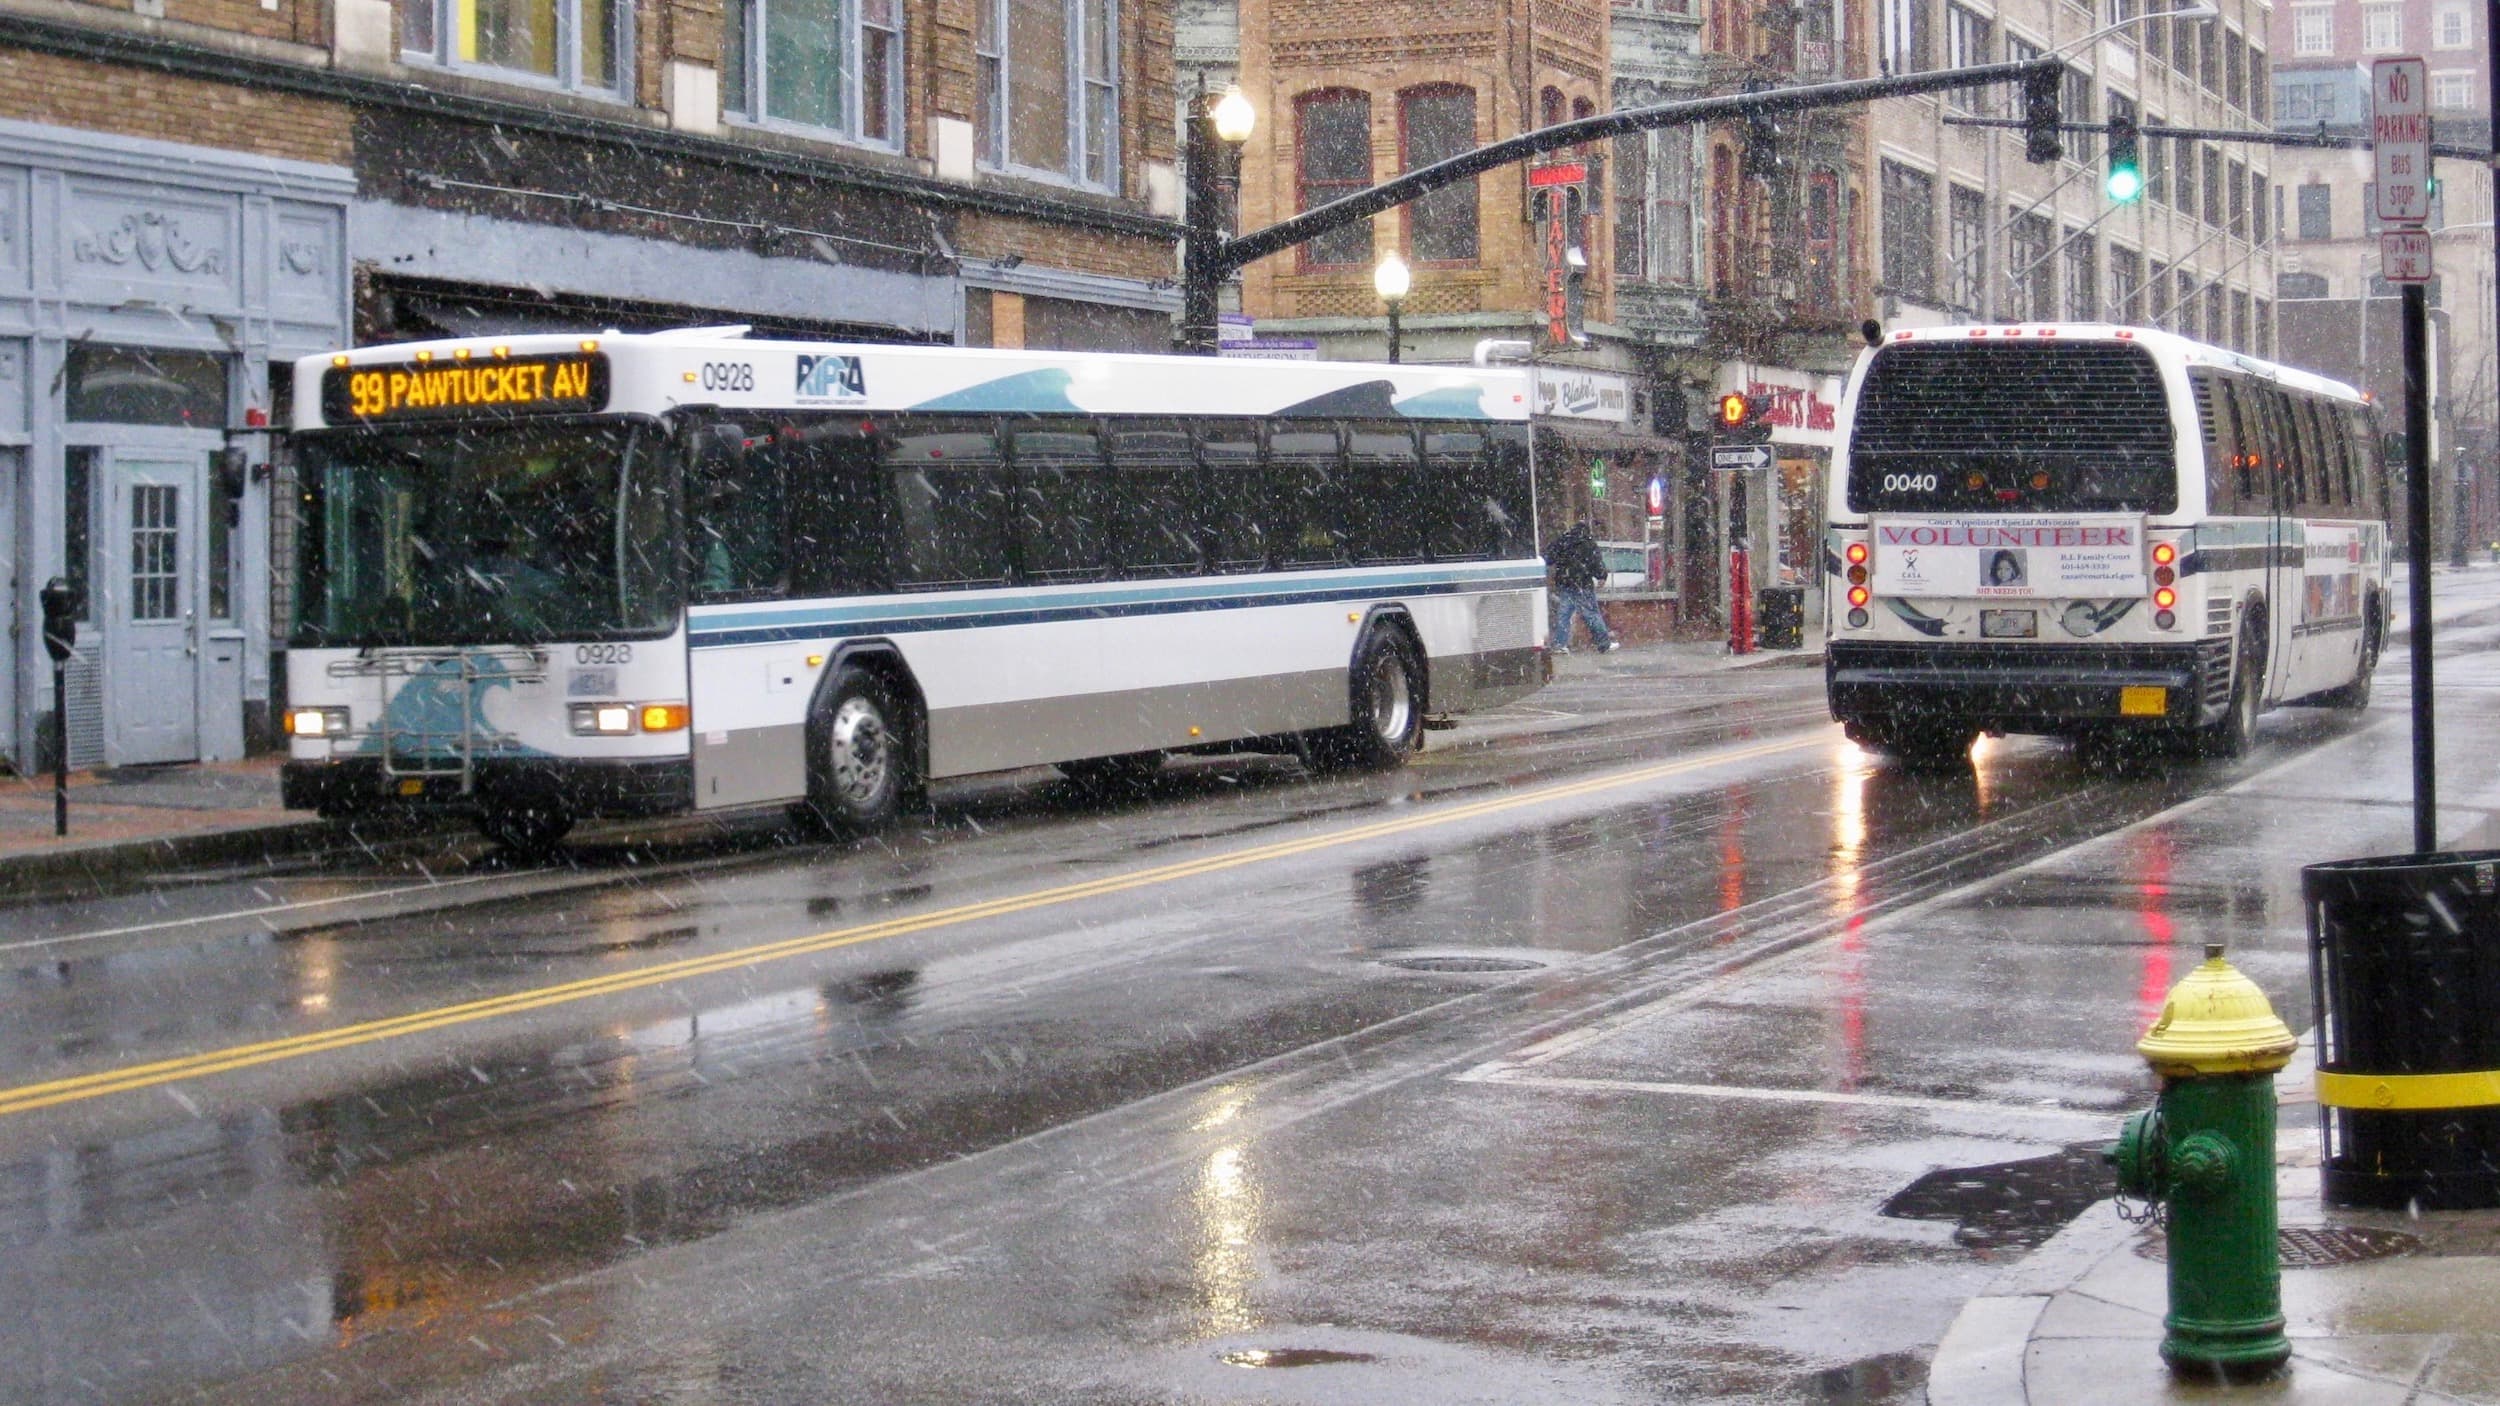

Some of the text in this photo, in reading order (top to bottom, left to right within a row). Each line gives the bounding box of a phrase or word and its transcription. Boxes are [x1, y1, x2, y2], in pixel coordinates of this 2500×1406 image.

[2389, 74, 2409, 103] NO
[2377, 114, 2424, 144] PARKING
[2391, 154, 2412, 176] BUS
[2390, 185, 2415, 206] STOP
[1550, 191, 1566, 345] TAVERN
[2394, 258, 2416, 273] ZONE
[702, 362, 754, 392] 0928
[352, 362, 588, 415] 99 PAWTUCKET AV
[1562, 376, 1598, 408] Blake's
[1717, 454, 1753, 464] ONE WAY
[1884, 474, 1937, 492] 0040
[1955, 518, 2000, 527] Appointed
[2002, 518, 2034, 526] Special
[1882, 527, 2131, 546] VOLUNTEER
[2078, 554, 2105, 562] Family
[1976, 587, 2033, 596] SHE NEEDS YOU
[575, 644, 633, 665] 0928
